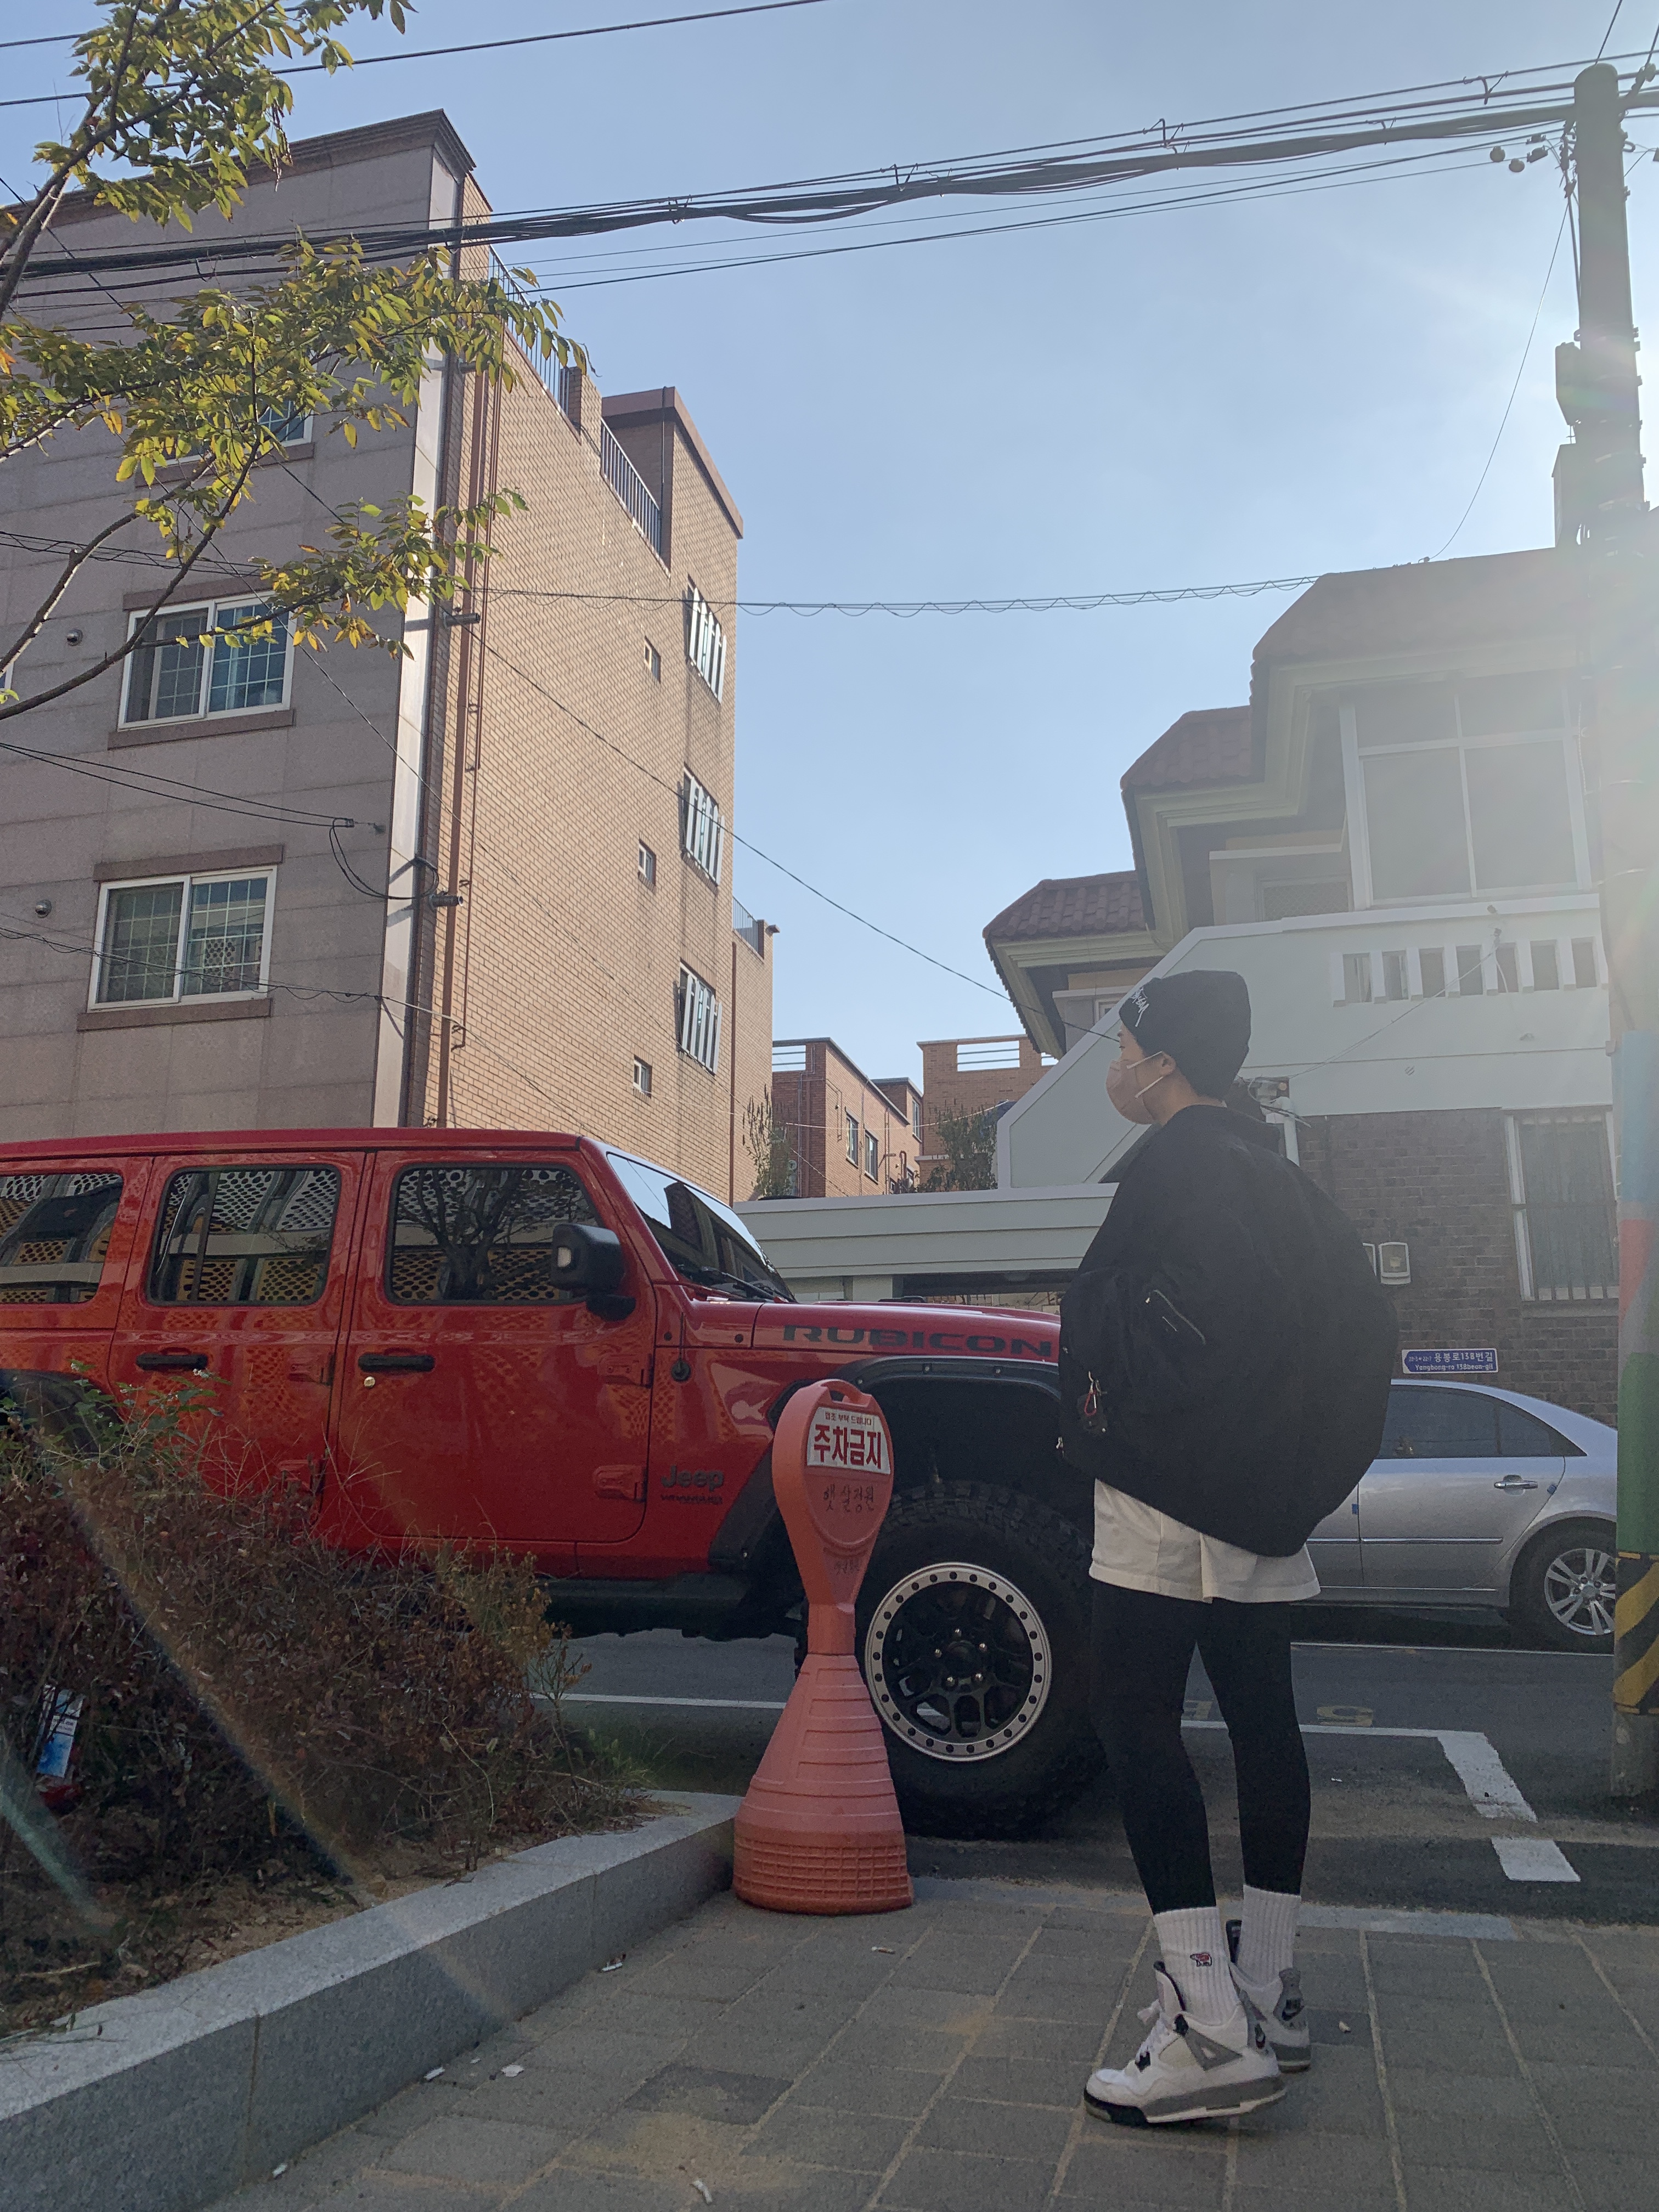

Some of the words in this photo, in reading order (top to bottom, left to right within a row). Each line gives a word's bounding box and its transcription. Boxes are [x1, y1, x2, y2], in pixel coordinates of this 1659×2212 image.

[783, 1324, 1052, 1357] RUBICON
[1434, 1352, 1493, 1363] 용봉로138번길
[838, 1413, 849, 1423] 부탁
[851, 1415, 872, 1426] 드립니다
[814, 1424, 881, 1469] 주차금지
[661, 1465, 724, 1492] Jeep
